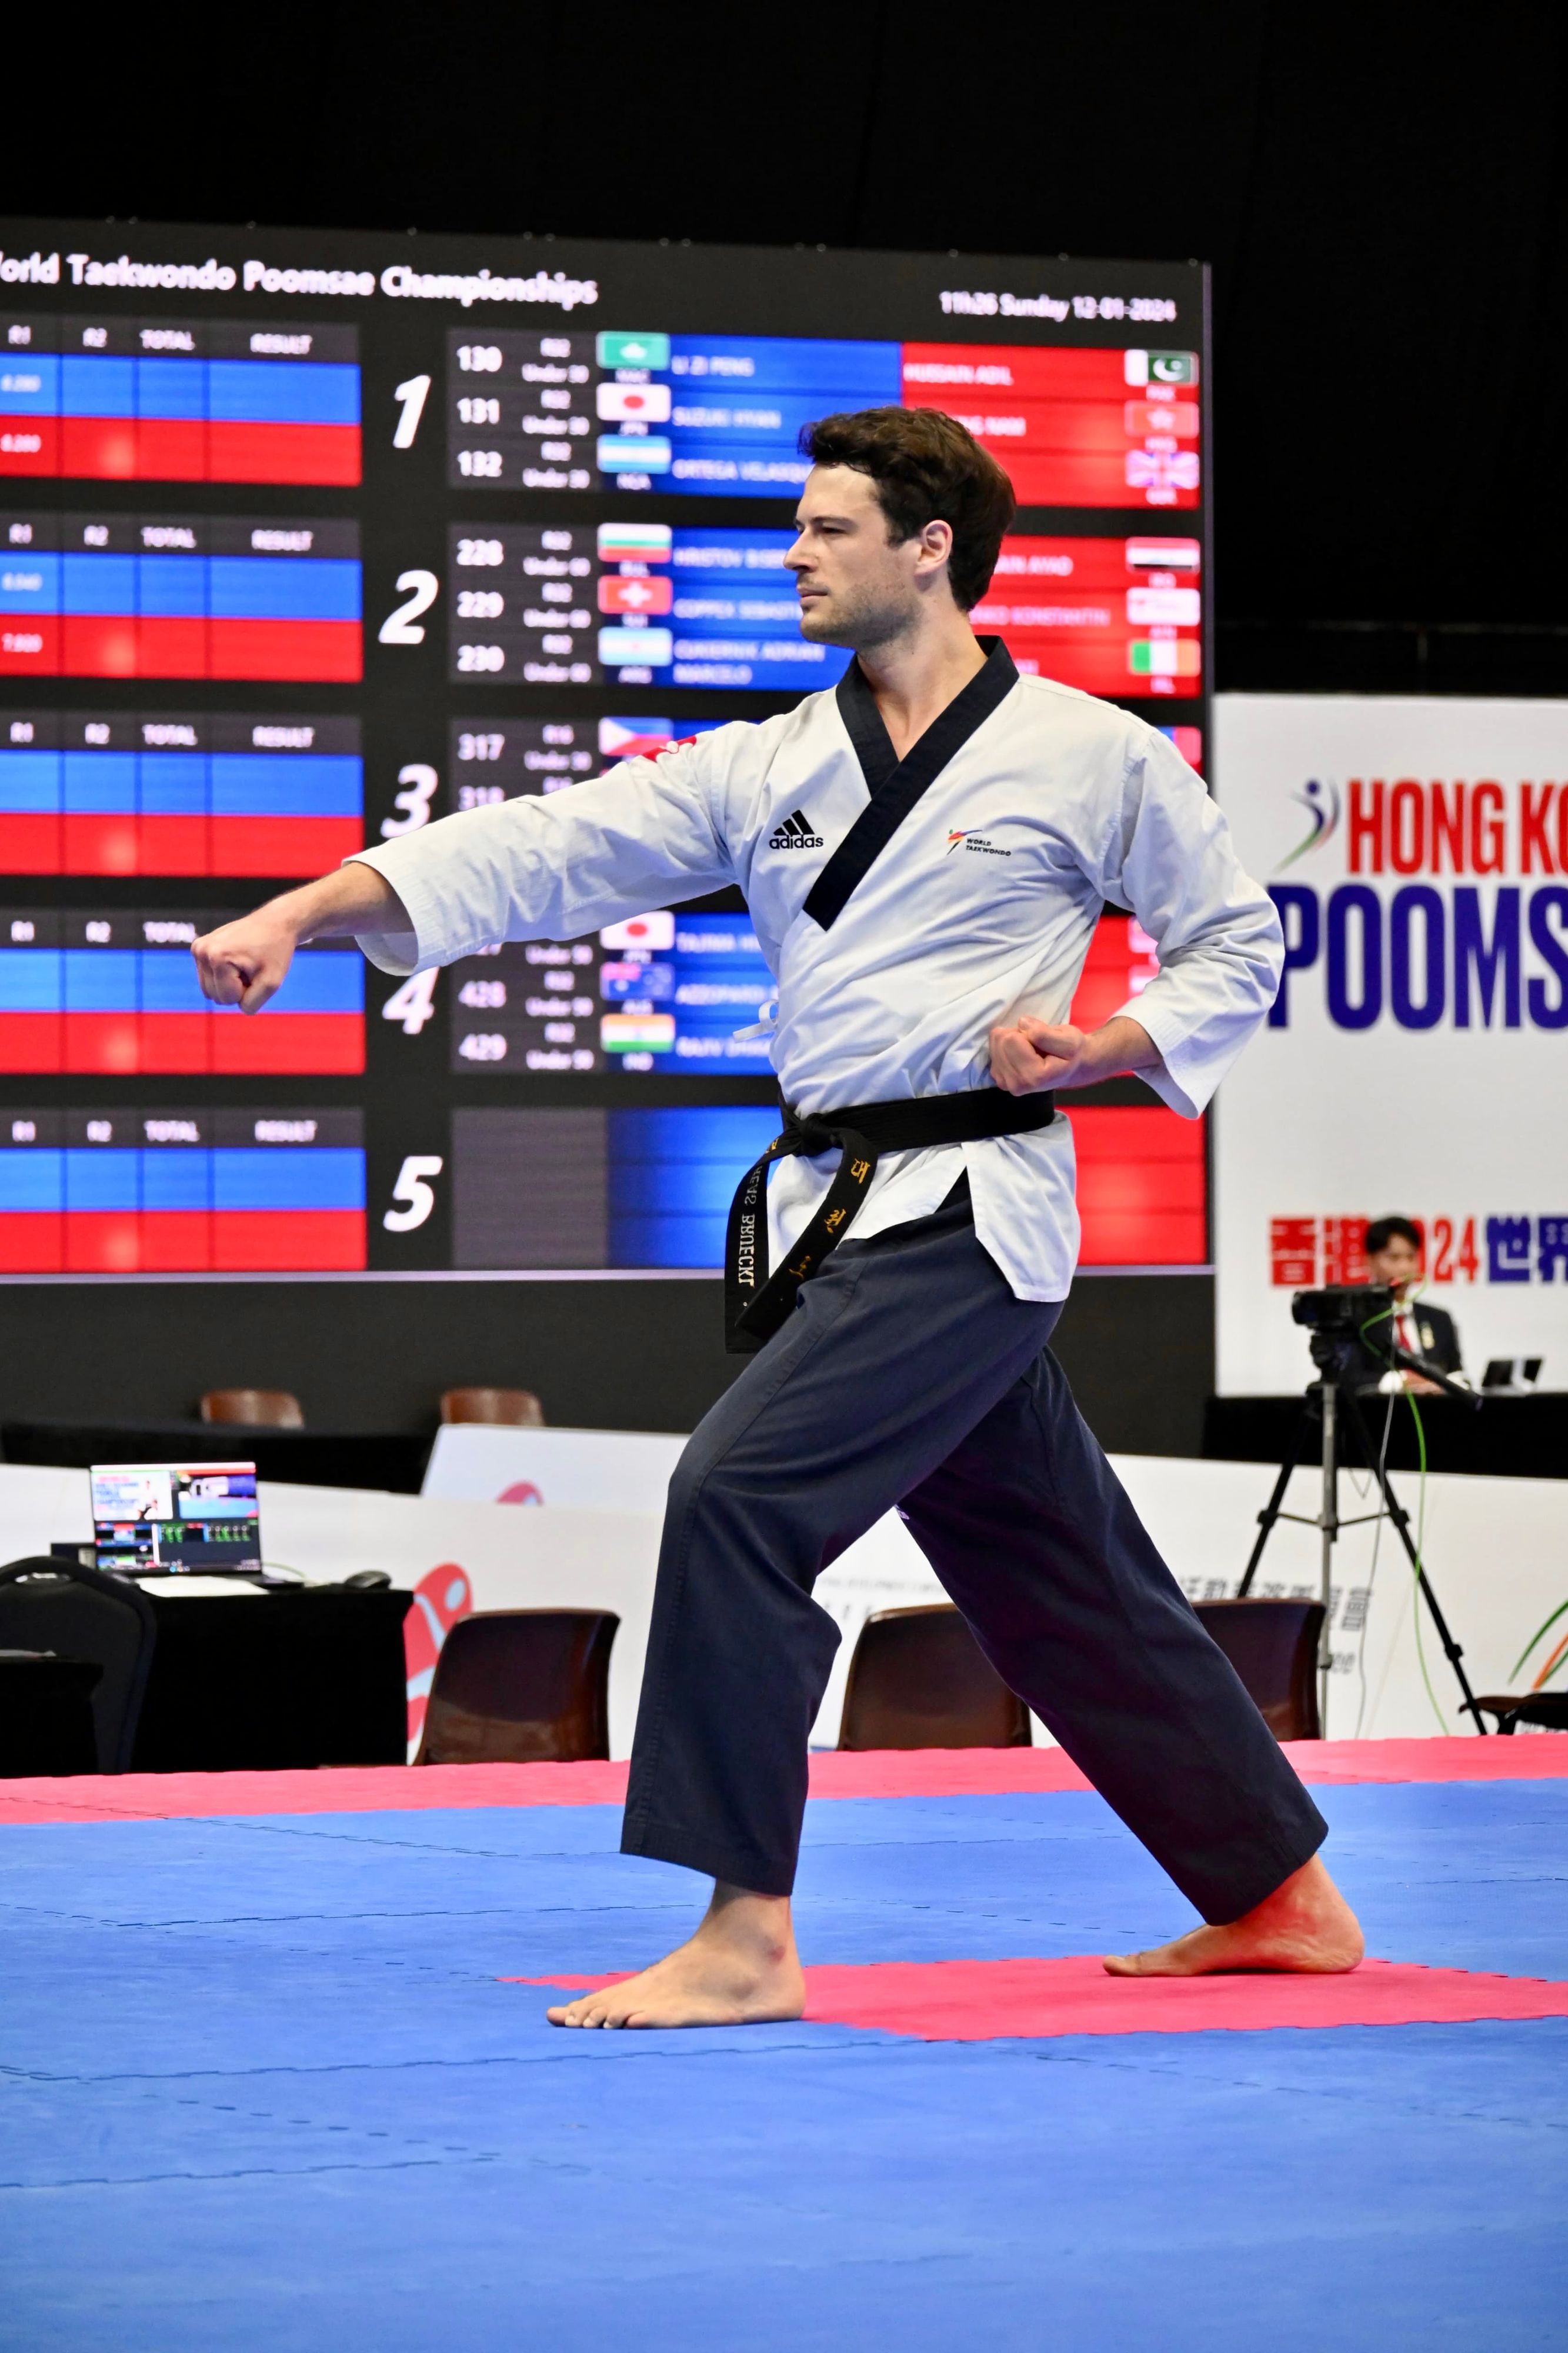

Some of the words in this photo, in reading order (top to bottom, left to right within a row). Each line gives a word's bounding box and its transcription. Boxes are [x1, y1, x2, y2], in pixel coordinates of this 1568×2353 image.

[0, 252, 59, 284] orld
[66, 254, 236, 291] Taekwondo
[243, 261, 376, 295] Poomsae
[381, 266, 598, 311] Championships
[999, 293, 1070, 322] Sunday
[140, 329, 195, 350] TOTAL
[251, 334, 312, 354] RESULT
[393, 375, 431, 448] 1
[141, 527, 196, 548] TOTAL
[252, 530, 313, 551] RESULT
[379, 570, 438, 644] 2
[142, 725, 197, 746] TOTAL
[253, 726, 314, 747] RESULT
[459, 734, 505, 760] 317
[381, 764, 439, 838] 3
[1347, 780, 1504, 875] HONG
[769, 834, 824, 850] adidas
[966, 837, 992, 847] WORLD
[966, 844, 1012, 857] TAEKWONDO
[144, 922, 196, 942] TOTAL
[382, 966, 435, 1034] 4
[145, 1120, 199, 1142] TOTAL
[255, 1120, 317, 1142] RESULT
[383, 1156, 443, 1232] 5
